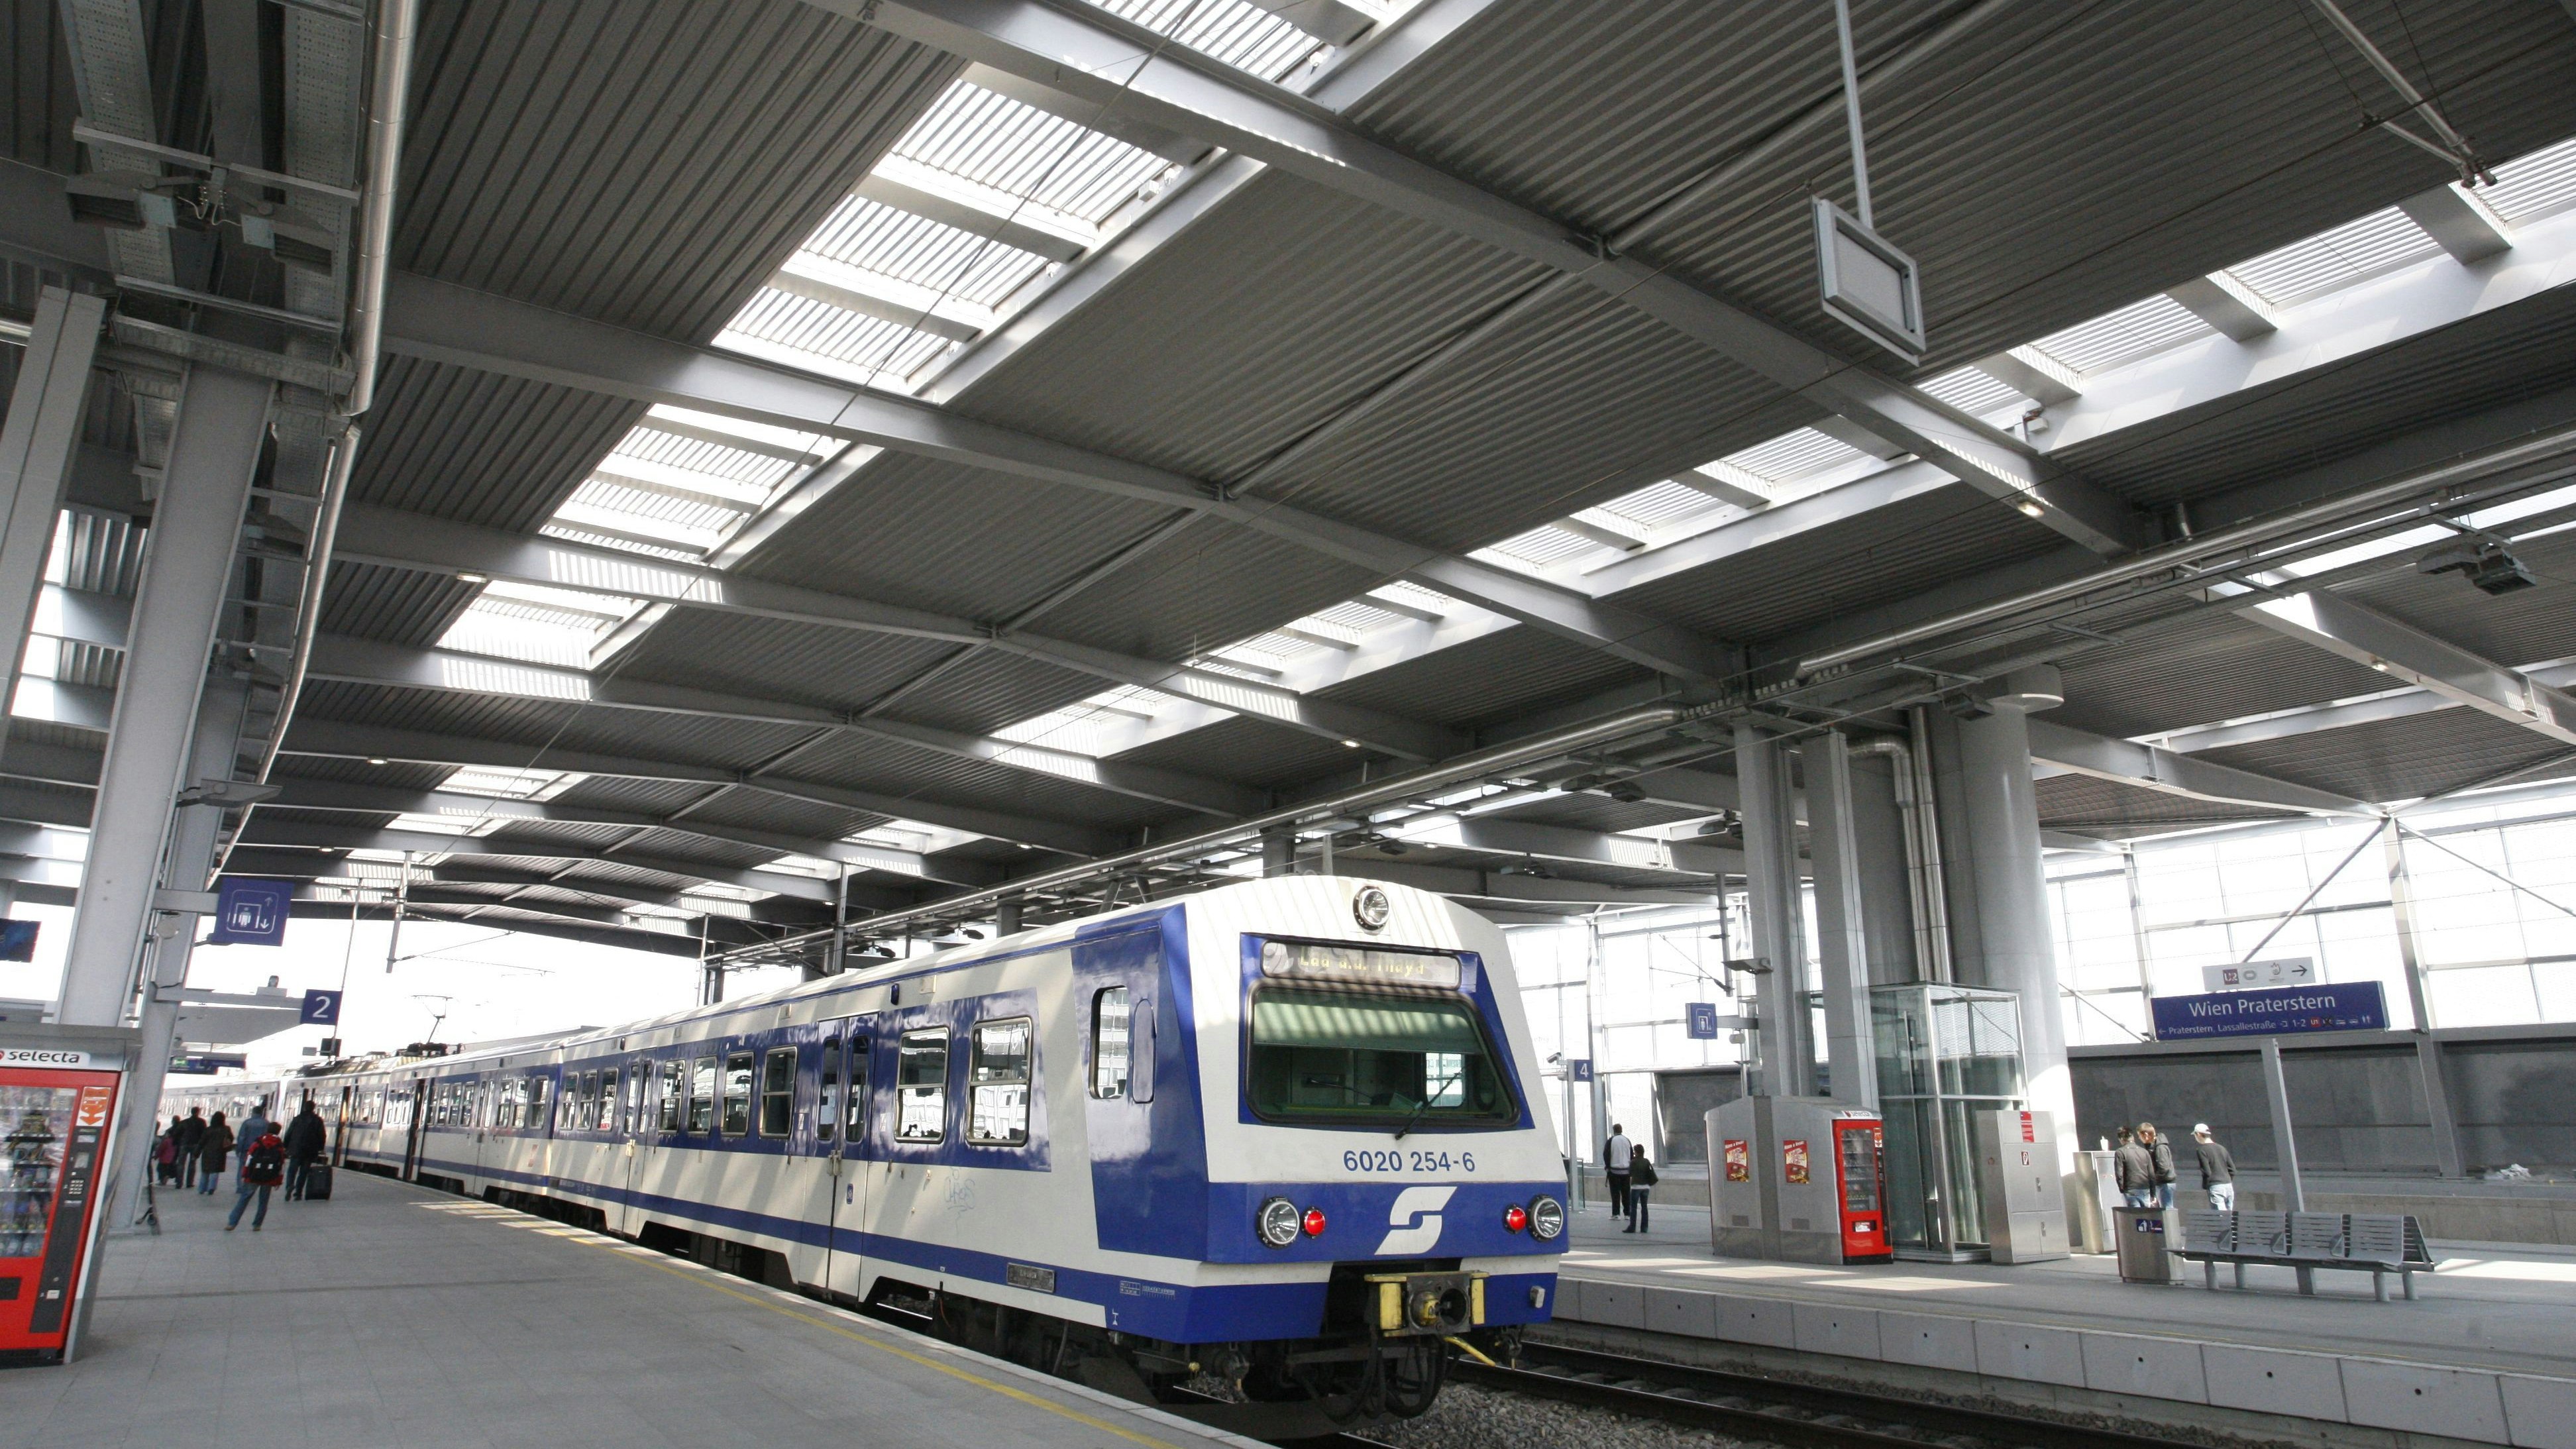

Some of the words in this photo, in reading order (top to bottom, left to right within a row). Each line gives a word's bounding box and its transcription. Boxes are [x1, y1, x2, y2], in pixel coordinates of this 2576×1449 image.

[2224, 972, 2238, 982] U2
[312, 996, 331, 1018] 2
[2188, 1001, 2232, 1017] Wien
[2237, 995, 2335, 1014] Praterstern
[2218, 1020, 2276, 1032] Lassallestraße
[2292, 1018, 2306, 1027] 1-2
[8, 1051, 80, 1063] selecta
[1580, 1063, 1589, 1078] 4
[1343, 1150, 1403, 1172] 6020
[1410, 1151, 1476, 1172] 254-6
